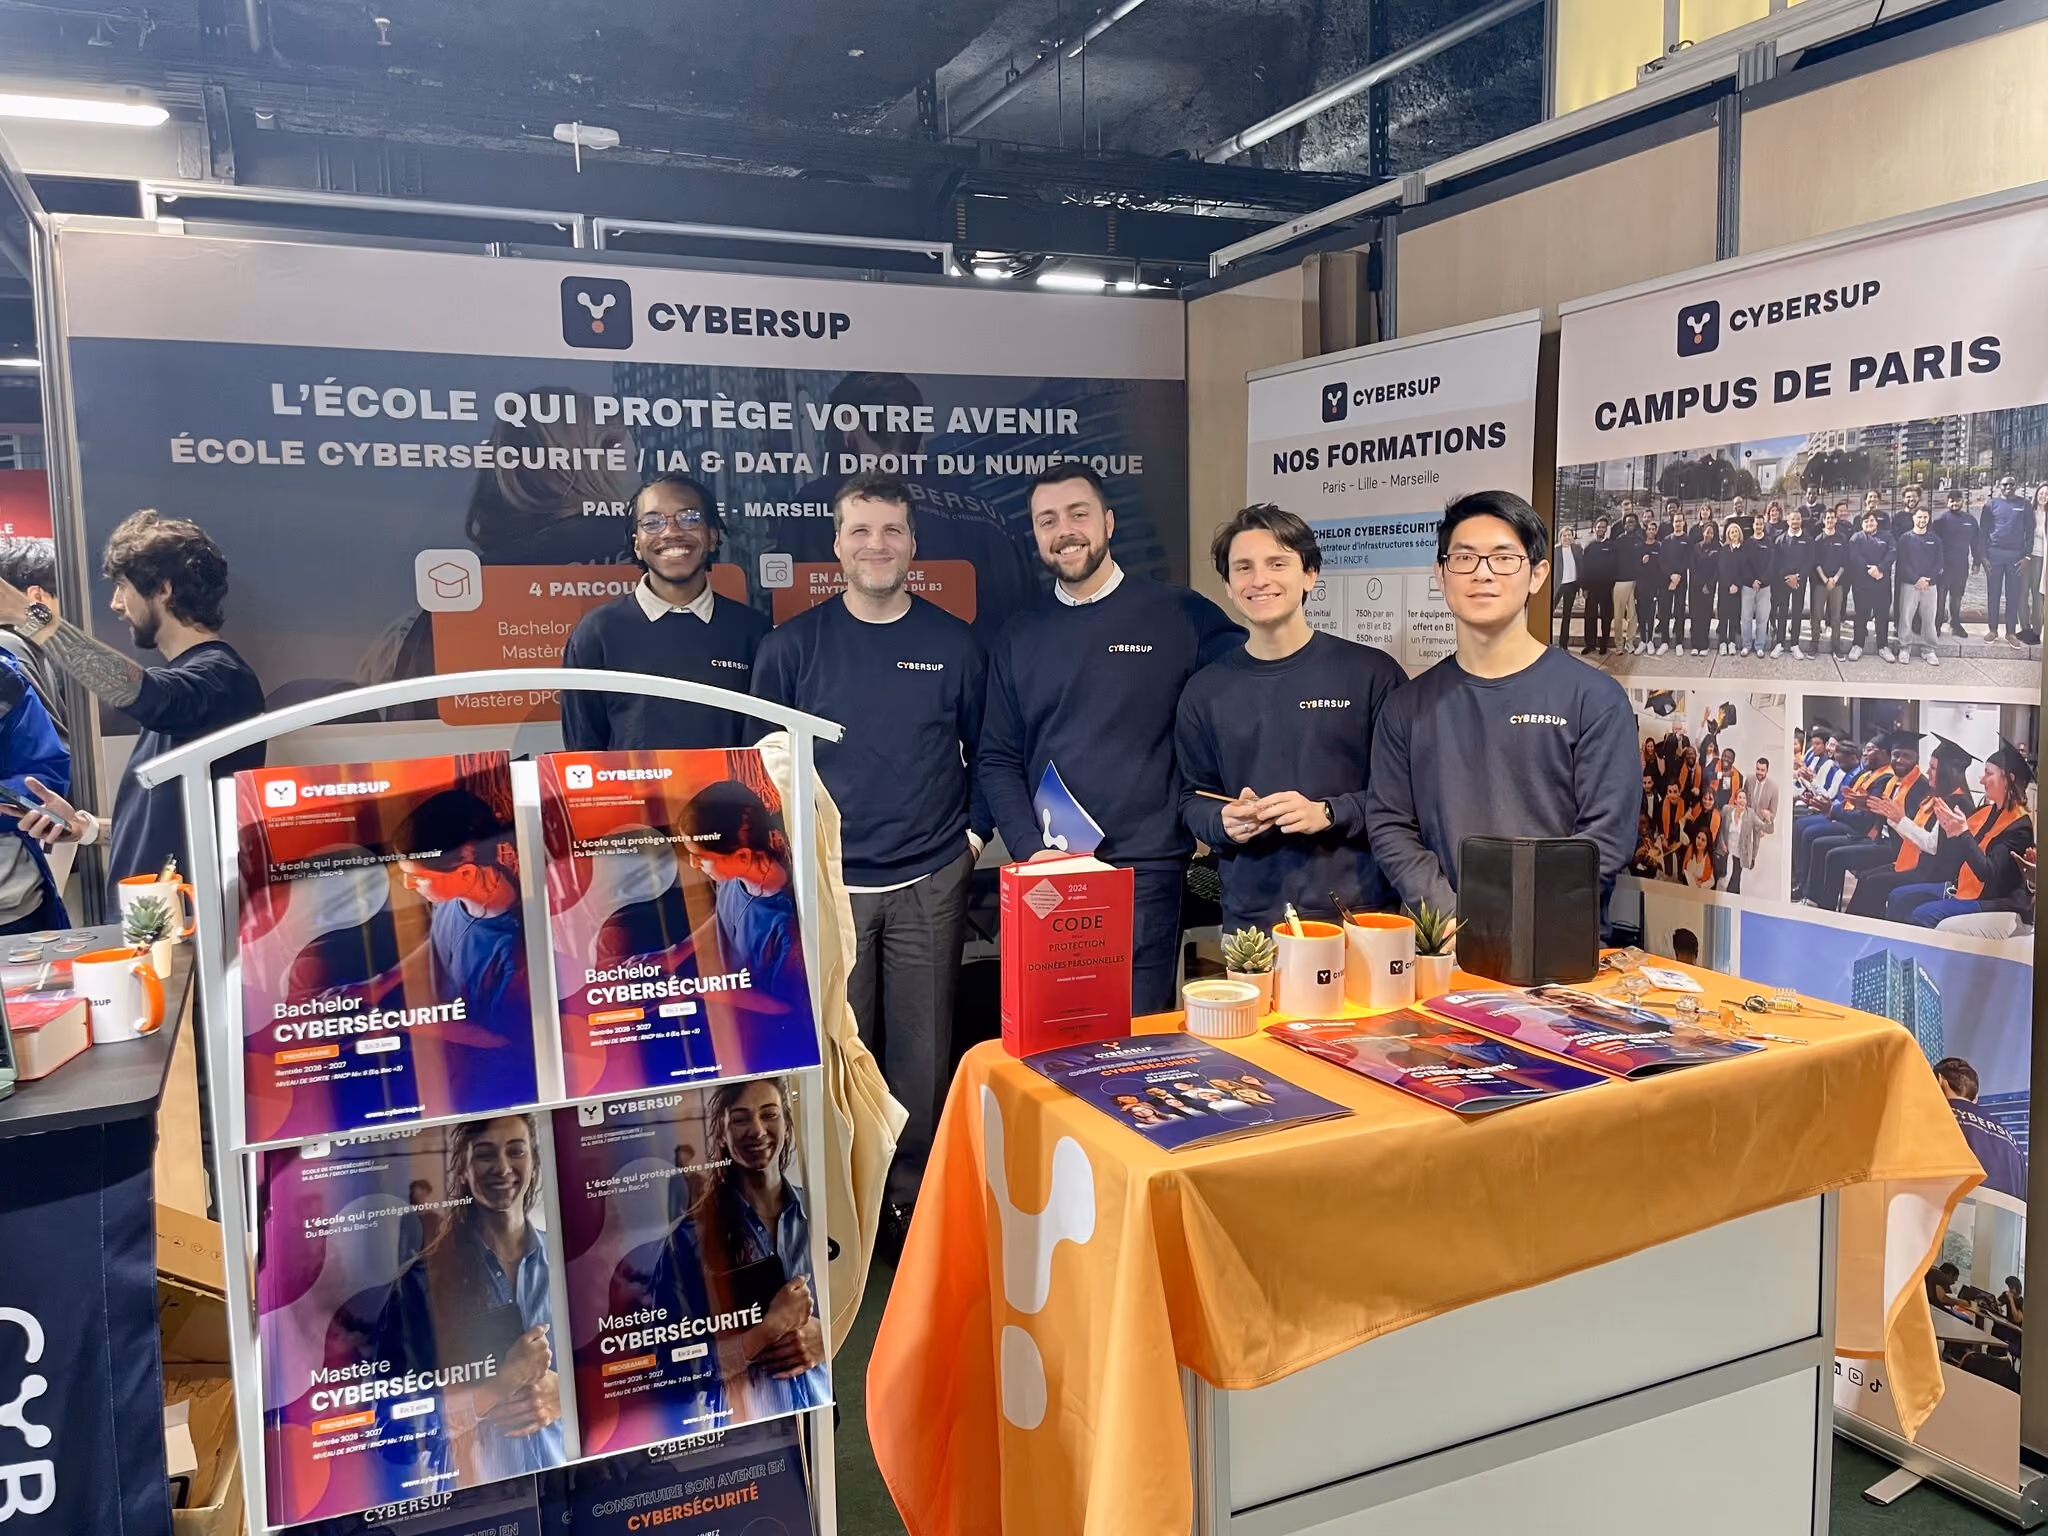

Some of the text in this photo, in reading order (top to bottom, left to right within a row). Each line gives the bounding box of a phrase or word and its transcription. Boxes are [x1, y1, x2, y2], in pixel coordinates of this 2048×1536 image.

[1729, 280, 1881, 333] CYBERSUP
[648, 302, 851, 340] CYBERSUP
[1595, 335, 2002, 431] CAMPUS DE PARIS
[1353, 376, 1441, 407] CYBERSUP
[494, 392, 577, 428] QUI
[594, 392, 794, 430] PROTÈGE
[805, 402, 935, 433] VOTRE
[946, 406, 1080, 435] AVENIR
[170, 431, 306, 465] ÉCOLE
[318, 439, 628, 472] CYBERSÉCURITÉ
[656, 450, 690, 473] IA
[700, 451, 725, 472] &
[735, 451, 814, 474] DATA
[839, 453, 928, 475] DROIT
[937, 454, 976, 476] DU
[1273, 421, 1507, 475] NOS FORMATIONS
[1322, 470, 1440, 495] Paris Lille Marseille
[744, 502, 835, 517] MARSEIL
[1313, 527, 1351, 540] CHELOR
[809, 573, 829, 584] EN
[529, 582, 543, 597] 4
[911, 583, 926, 592] DU
[928, 582, 942, 592] B3
[1313, 609, 1331, 618] initial
[1356, 609, 1371, 618] 750h
[1372, 610, 1384, 619] par
[1408, 610, 1418, 618] 1er
[498, 621, 573, 636] Bachelor
[1412, 622, 1433, 631] offert
[1445, 623, 1454, 631] B1
[1356, 634, 1372, 642] 550h
[1383, 634, 1393, 643] B3
[1422, 636, 1457, 645] Framewor
[1107, 643, 1153, 654] CYBERSUP
[1419, 648, 1443, 659] Laptop
[711, 659, 749, 670] CYBERSUP
[896, 660, 944, 672] CYBERSUP
[454, 693, 523, 709] Mastère
[1299, 699, 1351, 710] CYBERSUP
[1509, 713, 1568, 727] CYBERSUP
[596, 767, 673, 782] CYBERSUP
[300, 780, 391, 799] CYBERSUP
[610, 835, 627, 848] qui
[627, 833, 665, 847] protège
[666, 834, 691, 844] votre
[692, 832, 722, 842] avenir
[313, 858, 331, 870] qui
[333, 856, 376, 869] protège
[378, 852, 406, 863] votre
[408, 849, 443, 860] avenir
[1068, 884, 1088, 893] 2024
[1052, 915, 1103, 933] CODE
[1049, 939, 1106, 952] PROTECTION
[1028, 955, 1126, 972] DONNÉES PERSONNELLES
[584, 962, 662, 985] Bachelor
[586, 968, 752, 1006] CYBERSÉCURITÉ
[274, 995, 363, 1019] Bachelor
[274, 997, 467, 1043] CYBERSÉCURITÉ
[328, 1061, 347, 1070] 2027
[608, 1095, 683, 1116] CYBERSUP
[622, 1173, 638, 1185] qui
[640, 1168, 676, 1182] protège
[677, 1164, 702, 1174] votre
[704, 1158, 733, 1170] avenir
[587, 1190, 598, 1199] Du
[348, 1211, 366, 1224] qui
[368, 1205, 410, 1218] protège
[411, 1200, 440, 1212] votre
[441, 1195, 474, 1208] avenir
[305, 1230, 317, 1239] Du
[598, 1305, 668, 1333] Mastère
[600, 1302, 763, 1355] CYBERSÉCURITÉ
[310, 1360, 391, 1386] Mastère
[608, 1358, 650, 1373] PROGRAMME
[311, 1354, 497, 1411] CYBERSÉCURITÉ
[627, 1374, 643, 1384] 2026
[648, 1369, 664, 1379] 2027
[312, 1439, 340, 1449] Rentrée
[365, 1427, 383, 1438] 2027
[647, 1430, 726, 1458] CYBERSUP
[592, 1458, 786, 1517] CONSTRUIRE SON AVENIR EN
[363, 1492, 453, 1523] CYBERSUP
[627, 1482, 760, 1532] CYBERSÉCURITÉ
